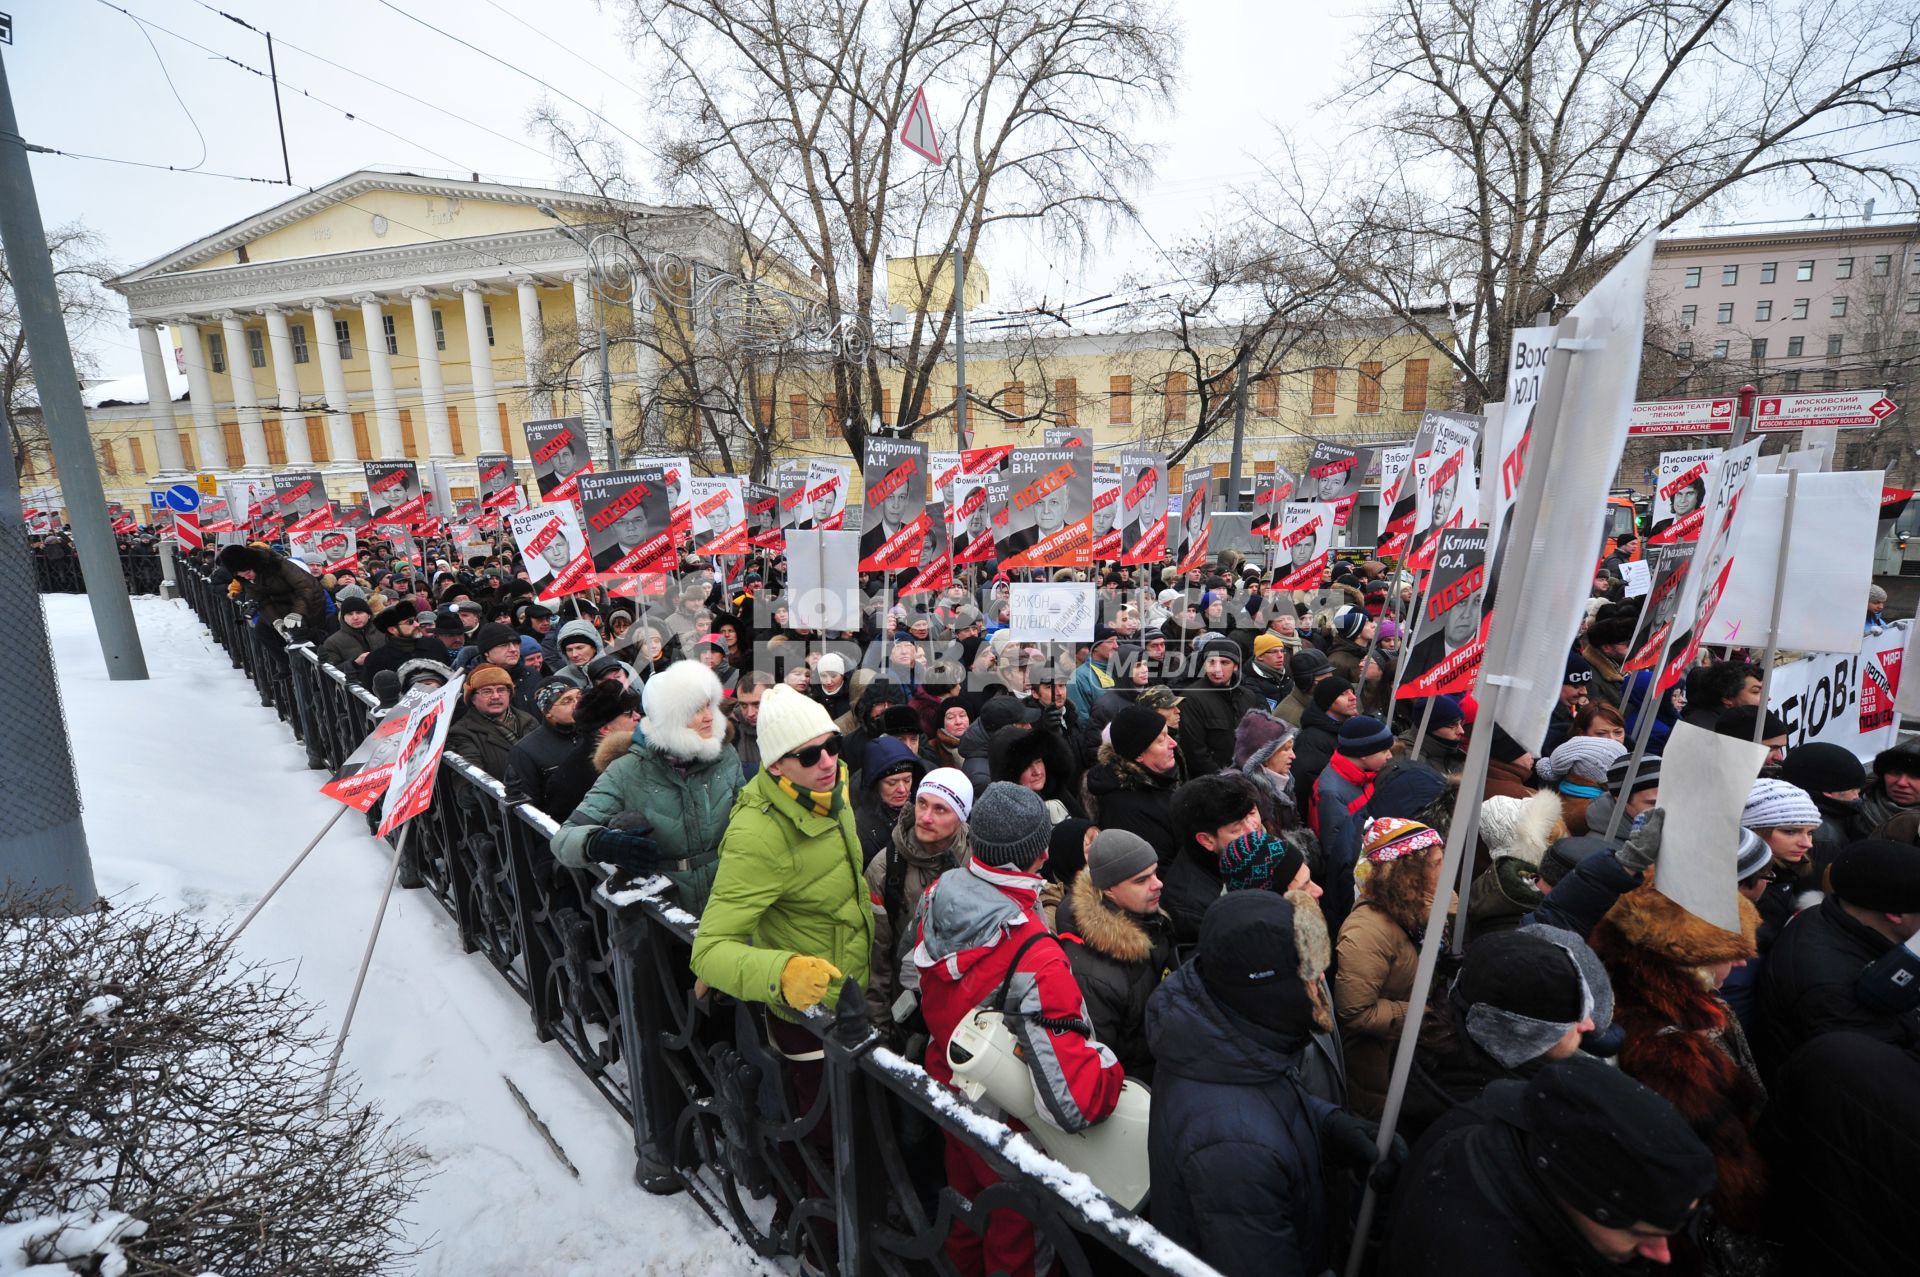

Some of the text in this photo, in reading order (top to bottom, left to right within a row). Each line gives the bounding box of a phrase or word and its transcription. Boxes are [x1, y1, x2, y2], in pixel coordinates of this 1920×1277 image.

[1795, 396, 1858, 405] МОСКОВСКИЙ
[1813, 404, 1863, 412] НИКУЛИНА
[526, 422, 563, 432] Аникеев
[1045, 430, 1071, 438] Сафин
[1641, 425, 1673, 433] LENKOM
[528, 432, 545, 441] Г.В.
[533, 427, 576, 465] ПОЗОР!
[867, 439, 921, 456] Хайруллин
[1317, 442, 1355, 457] Симагин
[867, 454, 888, 467] А.Н.
[1012, 451, 1073, 462] Федоткин
[1122, 454, 1155, 465] Шлегель
[1314, 450, 1332, 460] В.А.
[1662, 453, 1714, 464] Лисовский
[1012, 463, 1037, 474] В.Н.
[1123, 466, 1137, 477] Р.А.
[1310, 456, 1359, 480] ПОЗОР!
[1428, 447, 1464, 498] ПОЗОР!
[1662, 465, 1681, 474] С.Ф.
[581, 472, 662, 489] Калашников
[690, 480, 727, 488] Смирнов
[780, 481, 795, 489] А.В.
[867, 456, 919, 510] ПОЗОР!
[1012, 462, 1078, 511] ПОЗОР!
[1123, 465, 1159, 512] ПОЗОР!
[1659, 461, 1709, 502] ПОЗОР!
[552, 485, 571, 498] МАРШ
[583, 489, 610, 501] Л.И.
[806, 475, 841, 504] ПОЗОР!
[989, 493, 1008, 503] В.П.
[155, 493, 165, 506] P
[589, 483, 652, 533] ПОЗОР!
[693, 488, 734, 519] ПОЗОР!
[956, 487, 987, 522] ПОЗОР
[513, 509, 555, 526] Абрамов
[1403, 512, 1416, 527] МАР
[515, 524, 536, 535] В.С.
[524, 514, 567, 559] ПОЗОР!
[1282, 514, 1323, 550] ПОЗОР!
[1663, 524, 1683, 539] МАРШ
[874, 522, 920, 564] МАРШ ПРОТИВ
[1026, 522, 1088, 560] МАРШ ПРОТИВ
[1132, 520, 1165, 558] МАРШ ПРОТИВ
[613, 534, 669, 574] МАРШ ПРОТИВ
[1043, 535, 1089, 563] ПОДЛЕЦОВ
[631, 543, 672, 573] ПОДЛЕЦОВ
[1439, 554, 1467, 568] Ф.А.
[549, 555, 588, 594] МАРШ ПРОТИВ
[910, 555, 947, 590] МАРШ ПРОТИВ
[1283, 571, 1300, 586] МАРШ
[1300, 558, 1322, 575] ПРОТИВ
[1427, 564, 1484, 621] ПОЗО
[1014, 594, 1050, 609] ЗАКОН
[1420, 642, 1485, 689] МАРШ ПРОТ
[1883, 651, 1901, 666] МАР
[1436, 651, 1484, 690] ПОДЛЕЦО
[1865, 661, 1890, 695] ПРОТИВ
[1861, 687, 1876, 697] 13.01
[1861, 695, 1876, 705] 2013
[1859, 709, 1892, 729] ПОДЛЕЦ
[399, 700, 444, 769] ПОЗОР!
